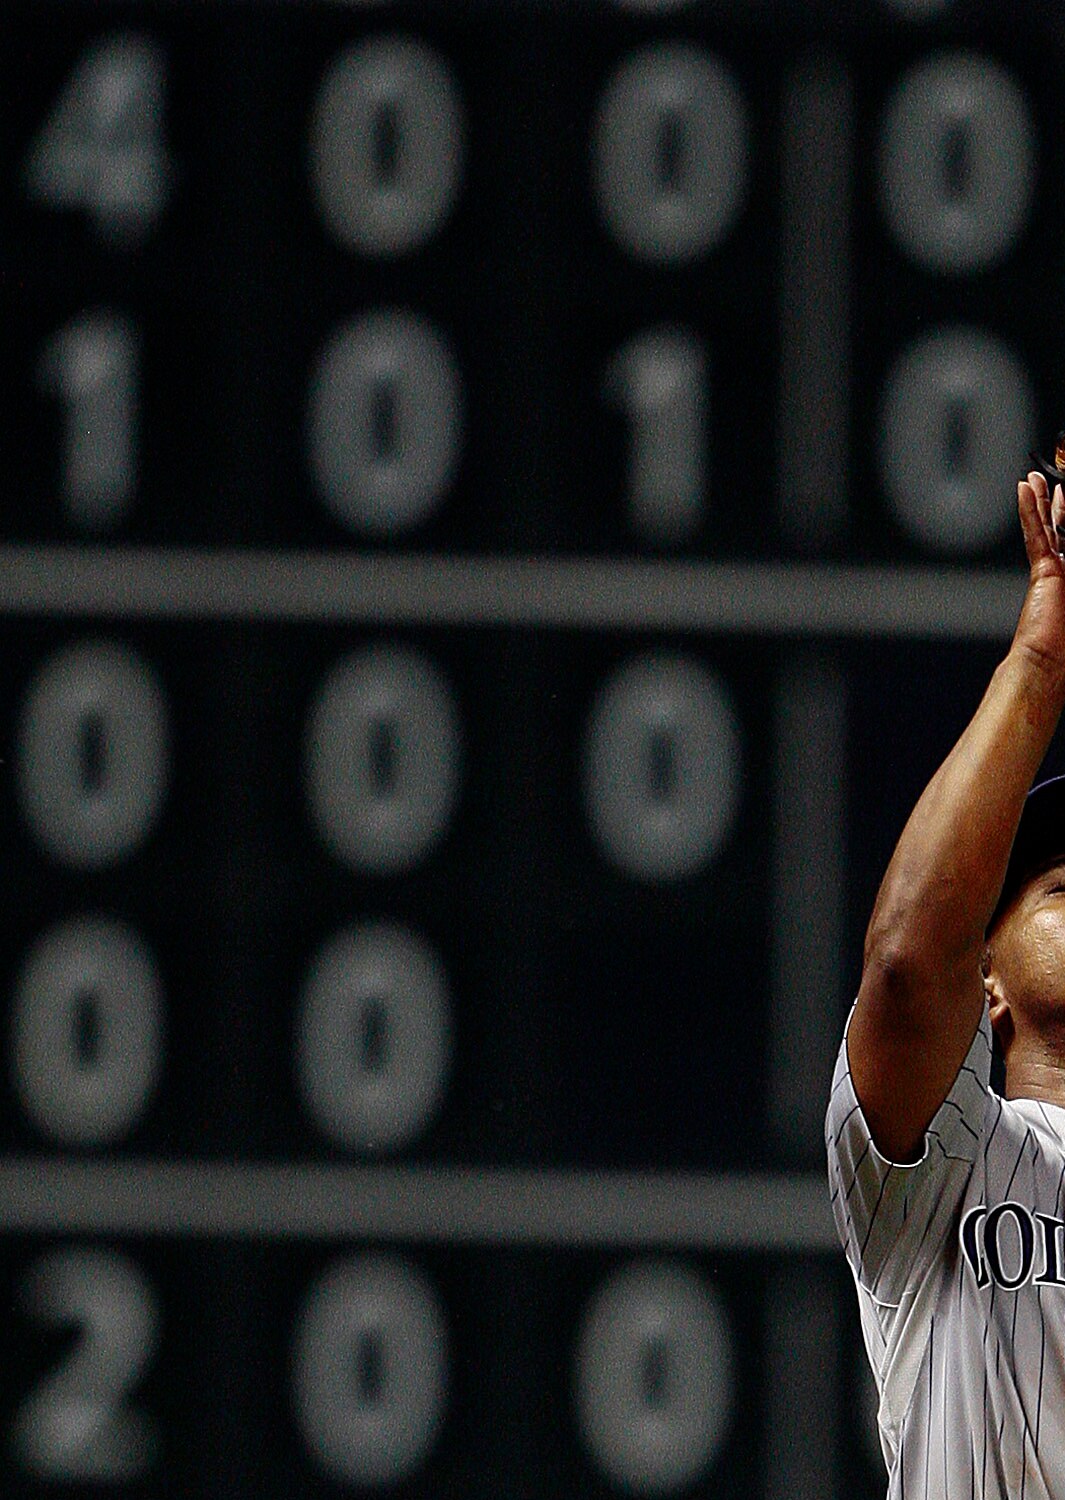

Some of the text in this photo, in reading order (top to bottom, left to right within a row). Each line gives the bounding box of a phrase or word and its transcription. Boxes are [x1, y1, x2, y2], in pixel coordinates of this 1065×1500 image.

[31, 37, 1027, 265] 4 0 0 0
[44, 315, 134, 522] 1
[315, 317, 455, 525] 0
[612, 330, 705, 537] 1
[887, 335, 1018, 543] 0
[25, 650, 734, 874] 0 0 0
[18, 925, 446, 1149] 0 0
[16, 1249, 157, 1479] 2
[299, 1260, 442, 1480] 0
[581, 1267, 728, 1488] 0
